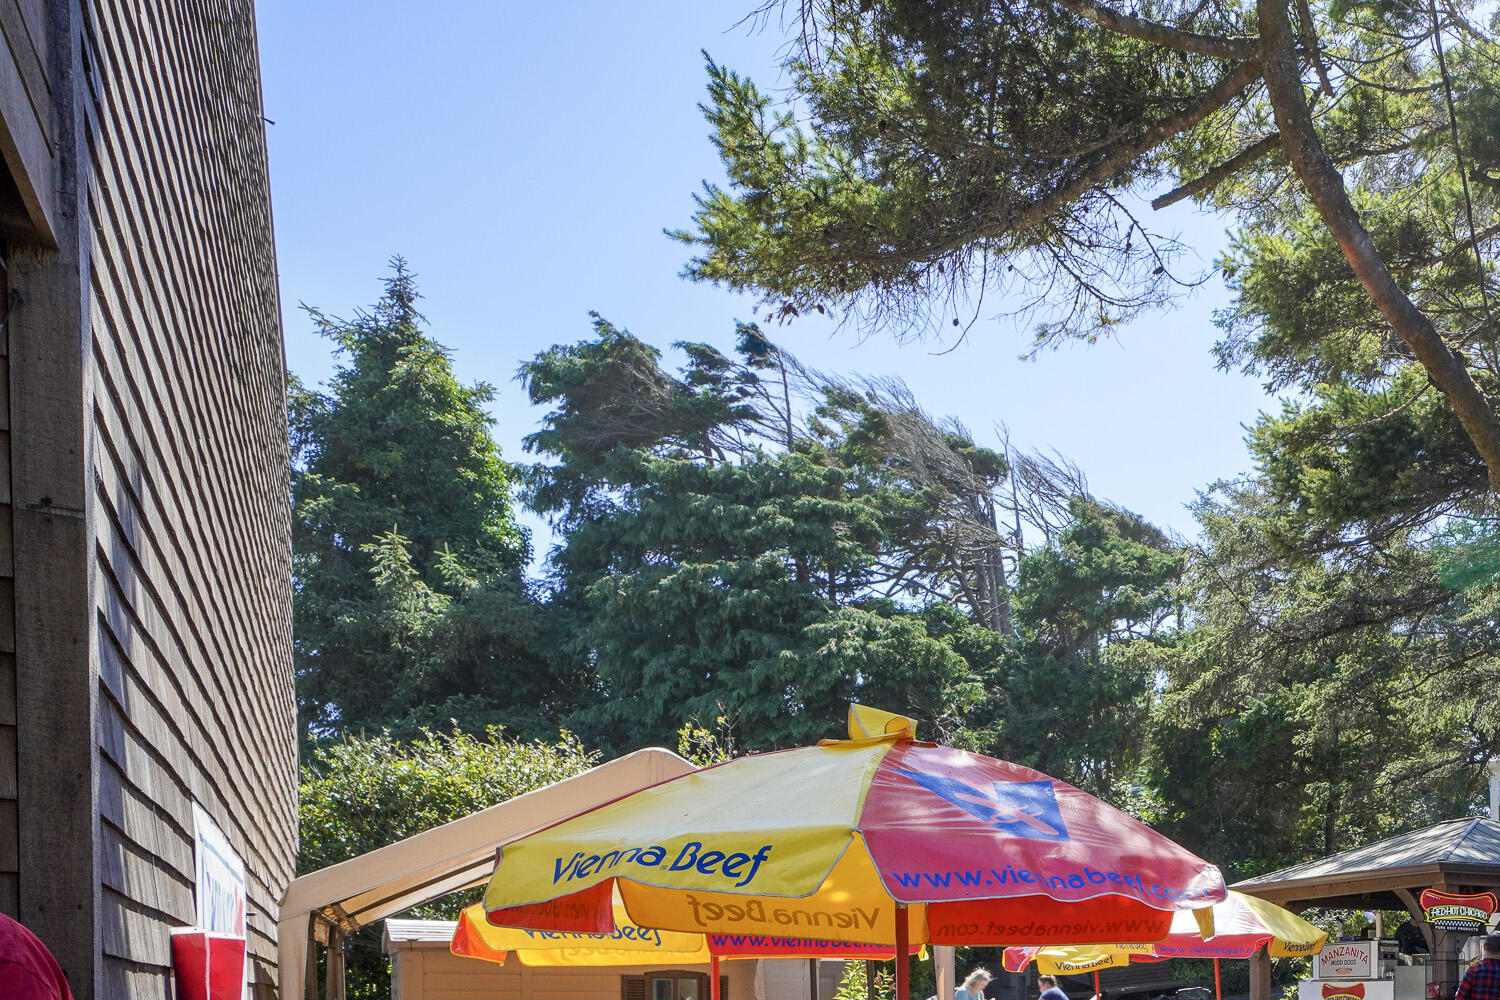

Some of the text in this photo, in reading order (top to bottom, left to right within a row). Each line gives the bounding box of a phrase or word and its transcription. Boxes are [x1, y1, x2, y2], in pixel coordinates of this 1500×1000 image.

[552, 842, 773, 887] Vienna Beef
[1321, 946, 1368, 966] MANZANITA
